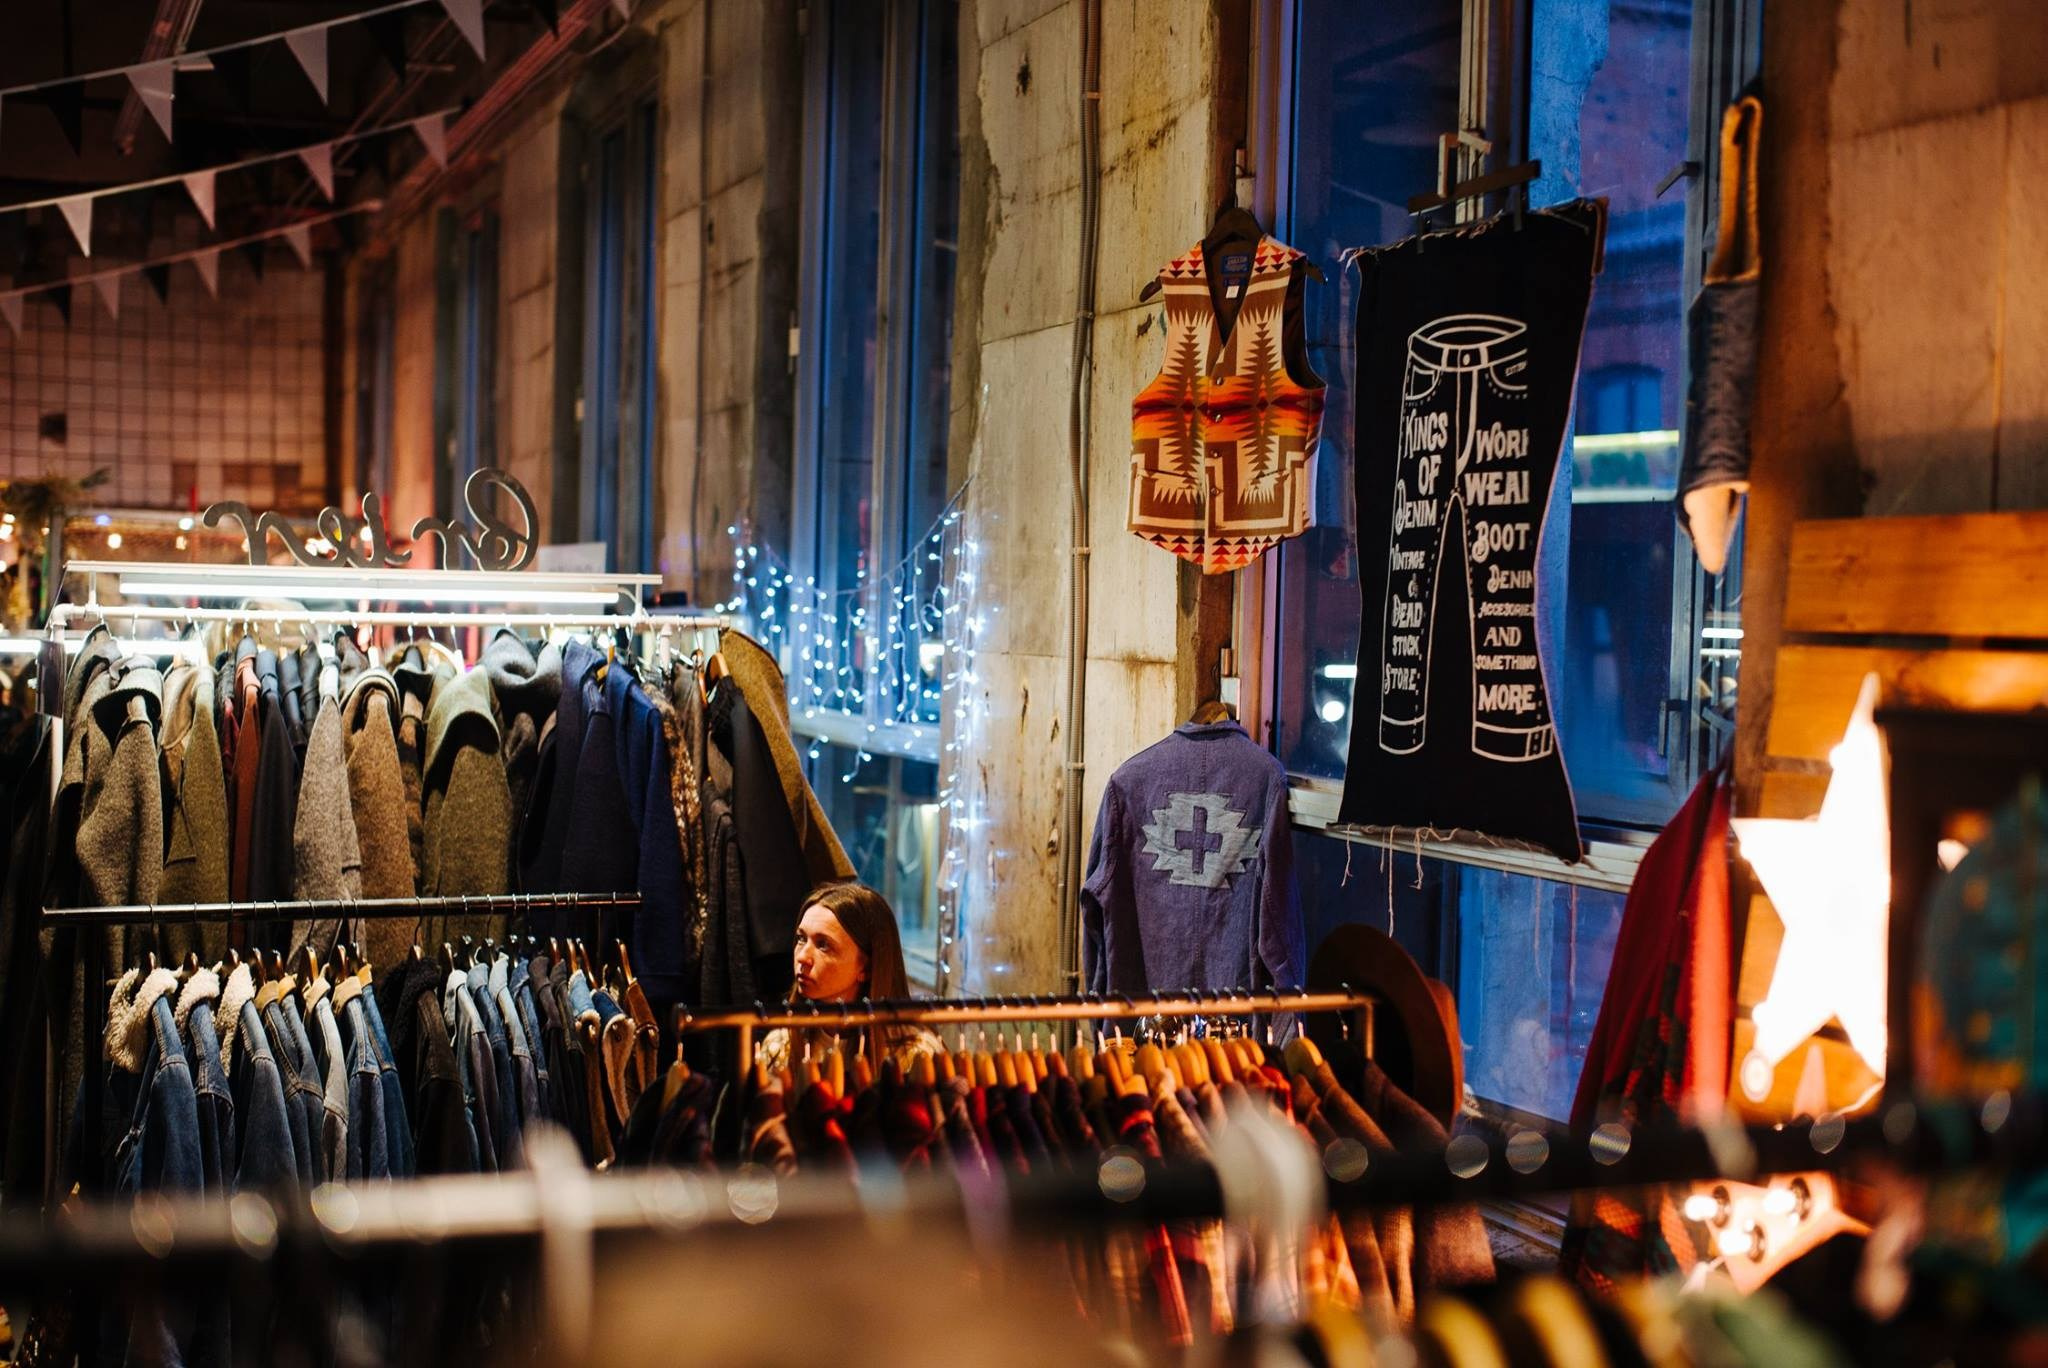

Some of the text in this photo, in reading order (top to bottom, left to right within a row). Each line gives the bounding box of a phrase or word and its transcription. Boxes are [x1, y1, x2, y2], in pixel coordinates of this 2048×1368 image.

[1403, 408, 1448, 459] KINGS
[1418, 455, 1441, 496] OF
[1395, 479, 1437, 535] DENIM
[1391, 543, 1426, 571] VINTAGE
[1471, 520, 1531, 564] BOOT
[1392, 594, 1423, 628] DEAD
[1392, 634, 1420, 656] STOCK
[1483, 626, 1522, 647] AND
[1475, 654, 1538, 670] SOMETHING
[1477, 683, 1537, 715] MORE
